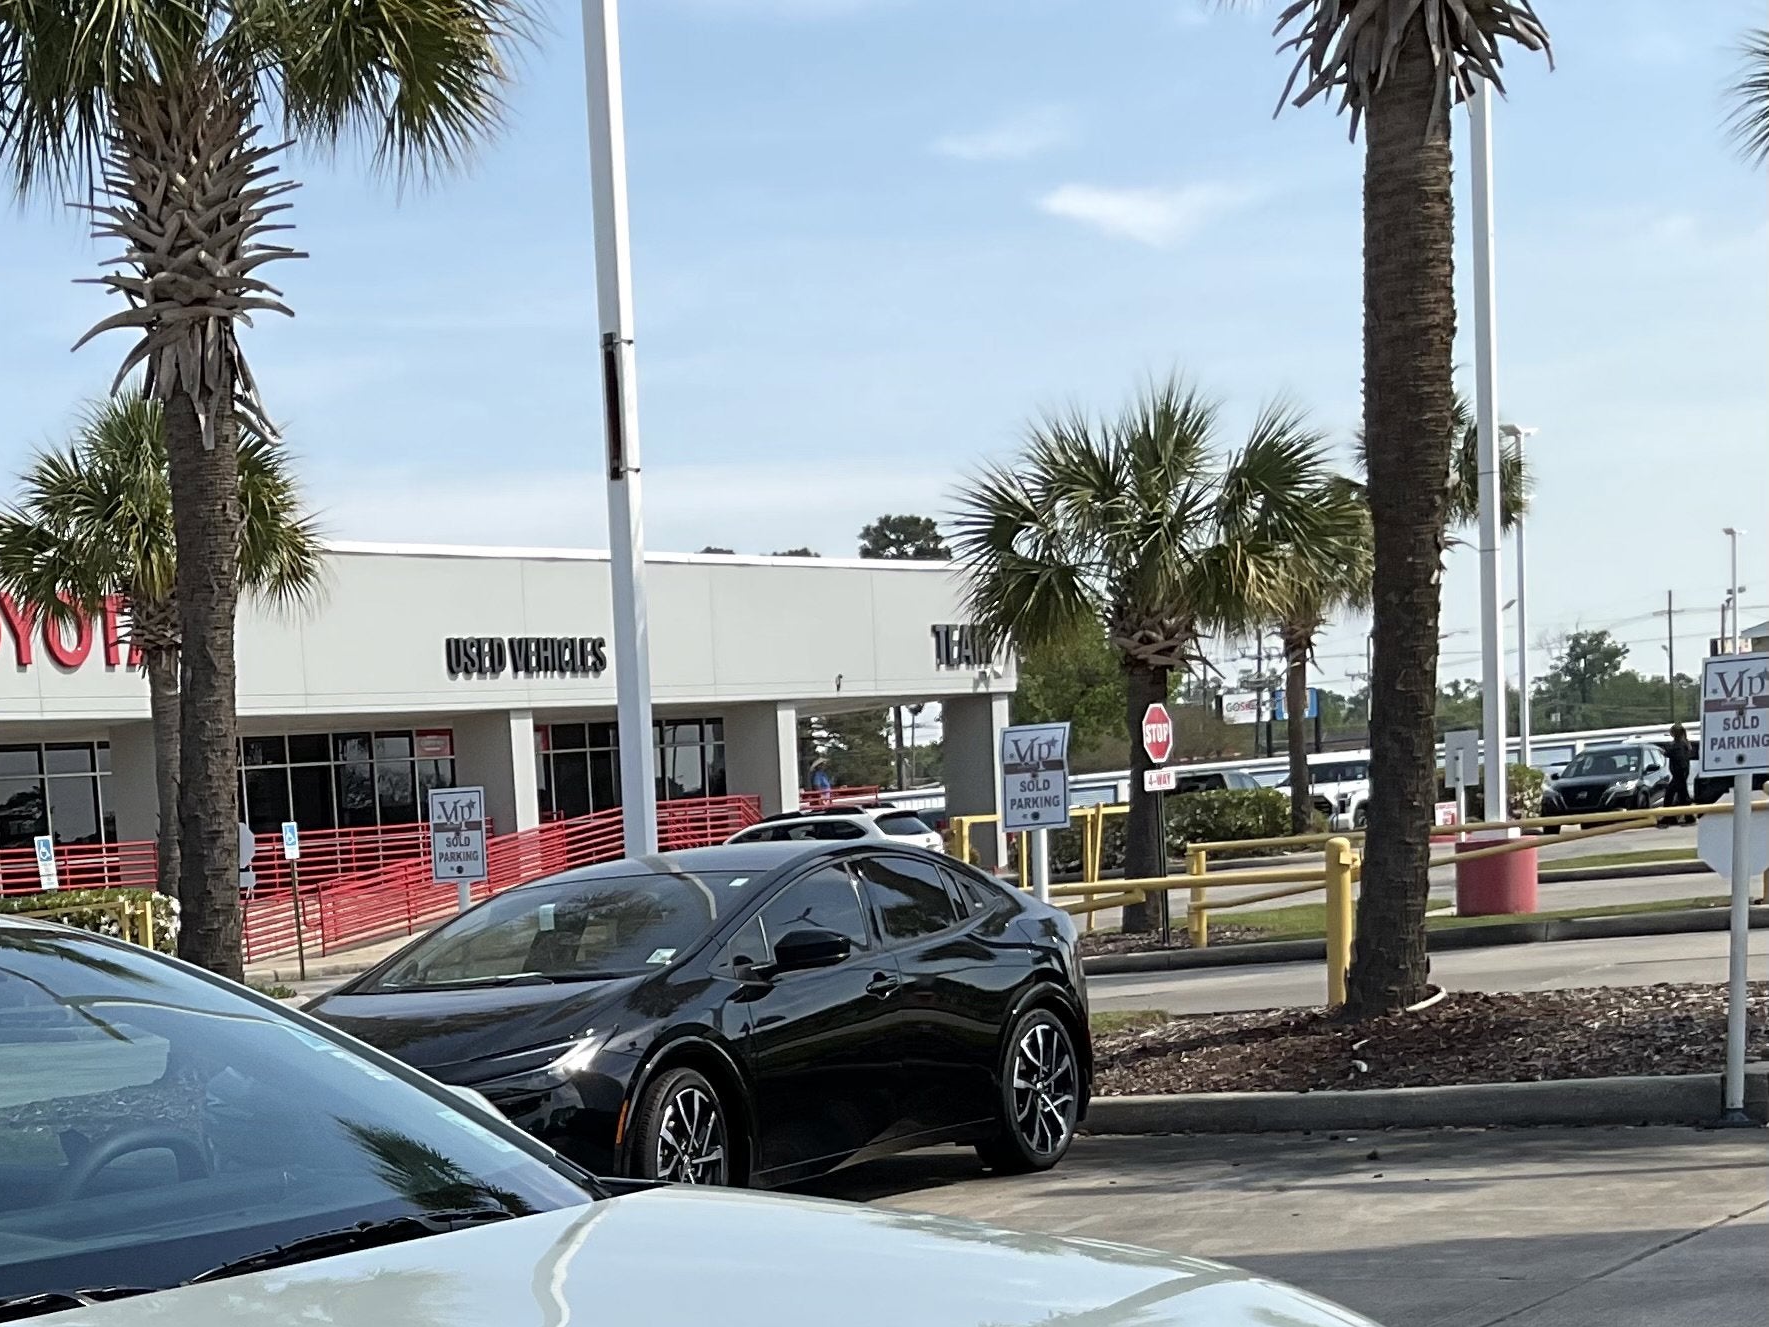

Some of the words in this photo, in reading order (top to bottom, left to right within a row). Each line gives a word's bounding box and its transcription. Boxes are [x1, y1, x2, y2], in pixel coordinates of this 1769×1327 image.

[446, 637, 506, 674] USED
[508, 637, 607, 673] VEHICLES
[1723, 716, 1760, 731] SOLD
[1145, 723, 1168, 743] STOP
[1710, 734, 1769, 751] PARKING
[1019, 779, 1051, 793] SOLD
[1148, 773, 1171, 786] 4-WAY
[1010, 795, 1060, 810] PARKING
[445, 836, 471, 847] SOLD
[438, 850, 479, 863] PARKING
